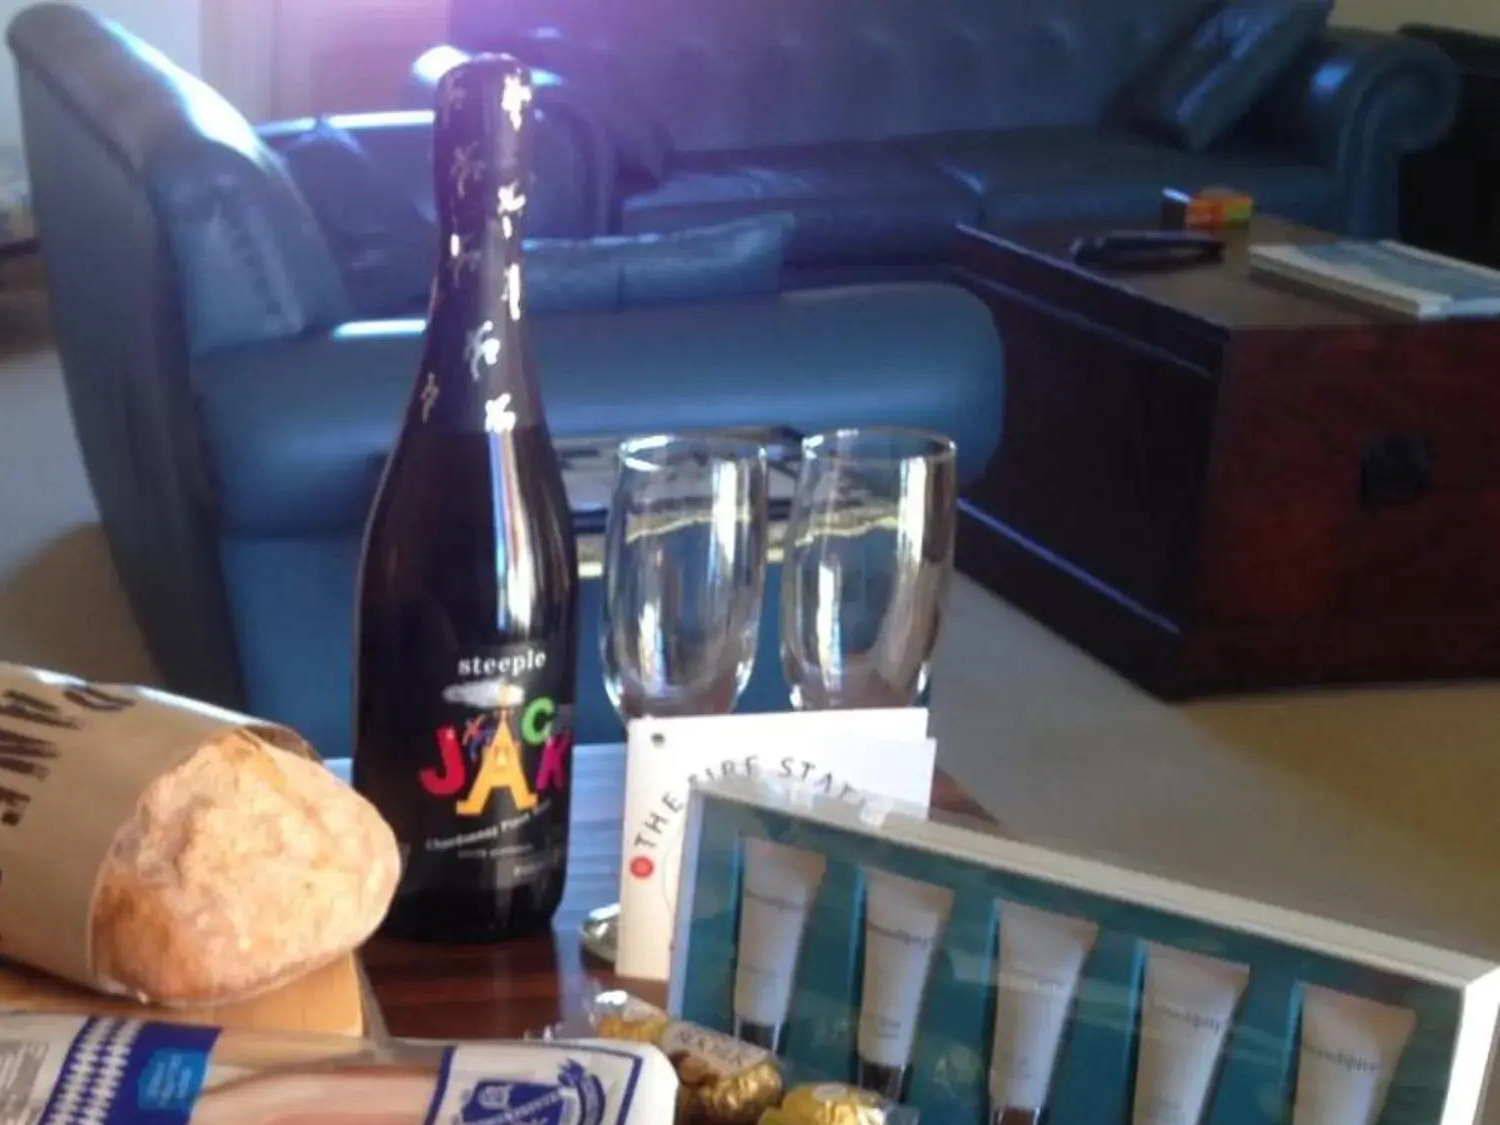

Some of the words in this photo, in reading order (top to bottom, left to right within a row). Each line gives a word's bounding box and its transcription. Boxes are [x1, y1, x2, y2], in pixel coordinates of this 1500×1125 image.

[457, 649, 547, 677] steeple
[633, 791, 685, 850] THE
[779, 756, 866, 803] STAT
